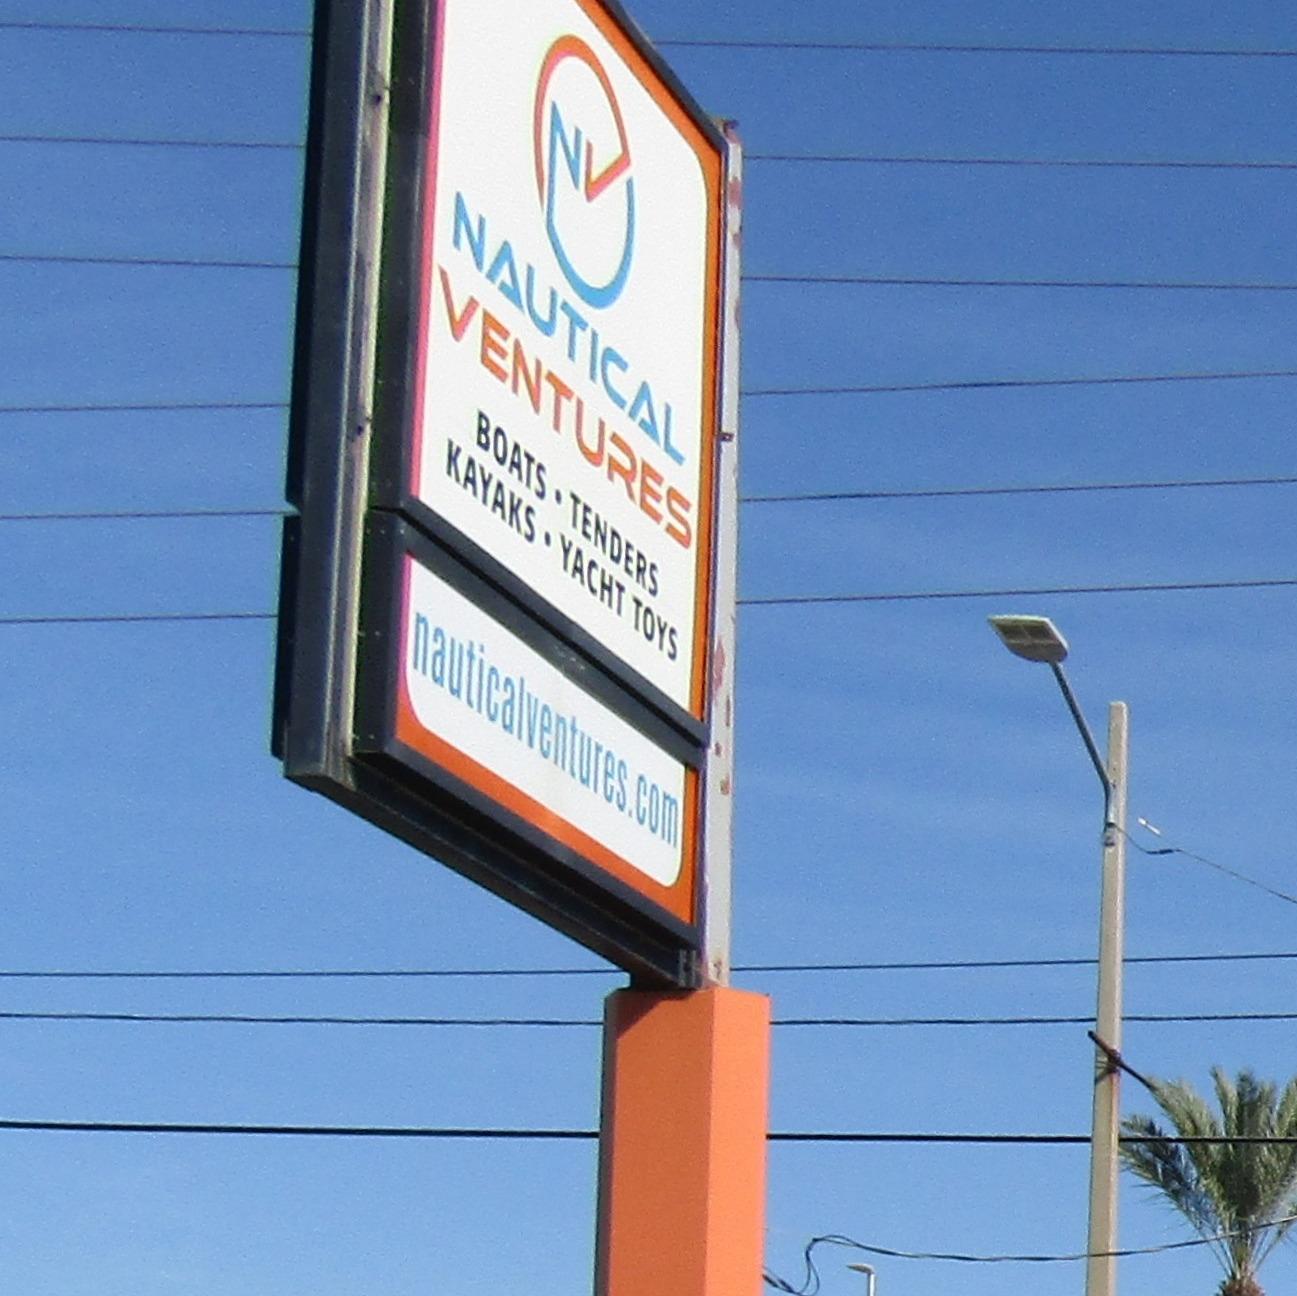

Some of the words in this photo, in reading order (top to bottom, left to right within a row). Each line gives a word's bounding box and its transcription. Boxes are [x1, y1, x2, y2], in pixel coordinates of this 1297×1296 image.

[437, 264, 693, 549] VENTURES
[452, 191, 686, 467] NAUTICAL
[446, 438, 537, 546] KAYAKS
[559, 532, 627, 617] YACHT
[632, 599, 679, 663] TOYS
[477, 410, 547, 499] BOATS
[570, 491, 660, 598] TENDERS
[412, 610, 680, 850] nauticalventures.com
